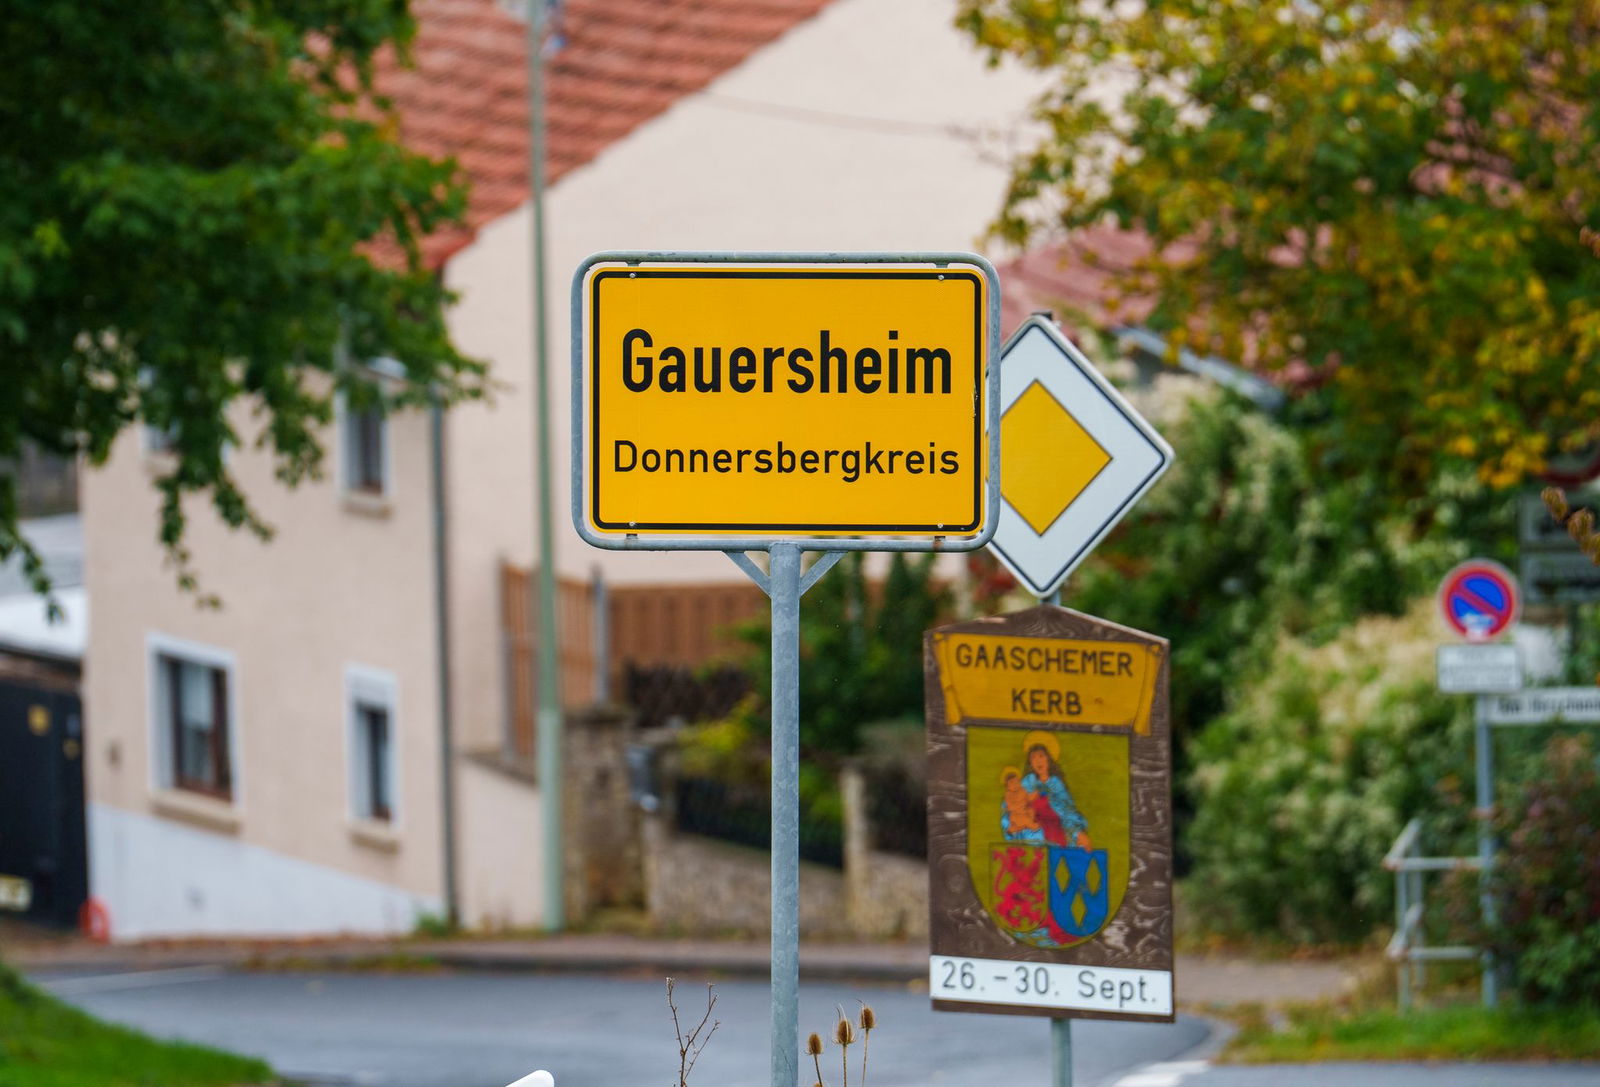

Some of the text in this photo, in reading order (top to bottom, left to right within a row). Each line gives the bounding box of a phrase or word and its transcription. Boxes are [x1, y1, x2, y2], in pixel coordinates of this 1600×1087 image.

[622, 328, 952, 394] Gauersheim
[614, 439, 960, 483] Donnersbergkreis
[955, 642, 1134, 677] GAASCHEMER
[1011, 688, 1082, 716] KERB
[1077, 969, 1157, 1008] Sept.
